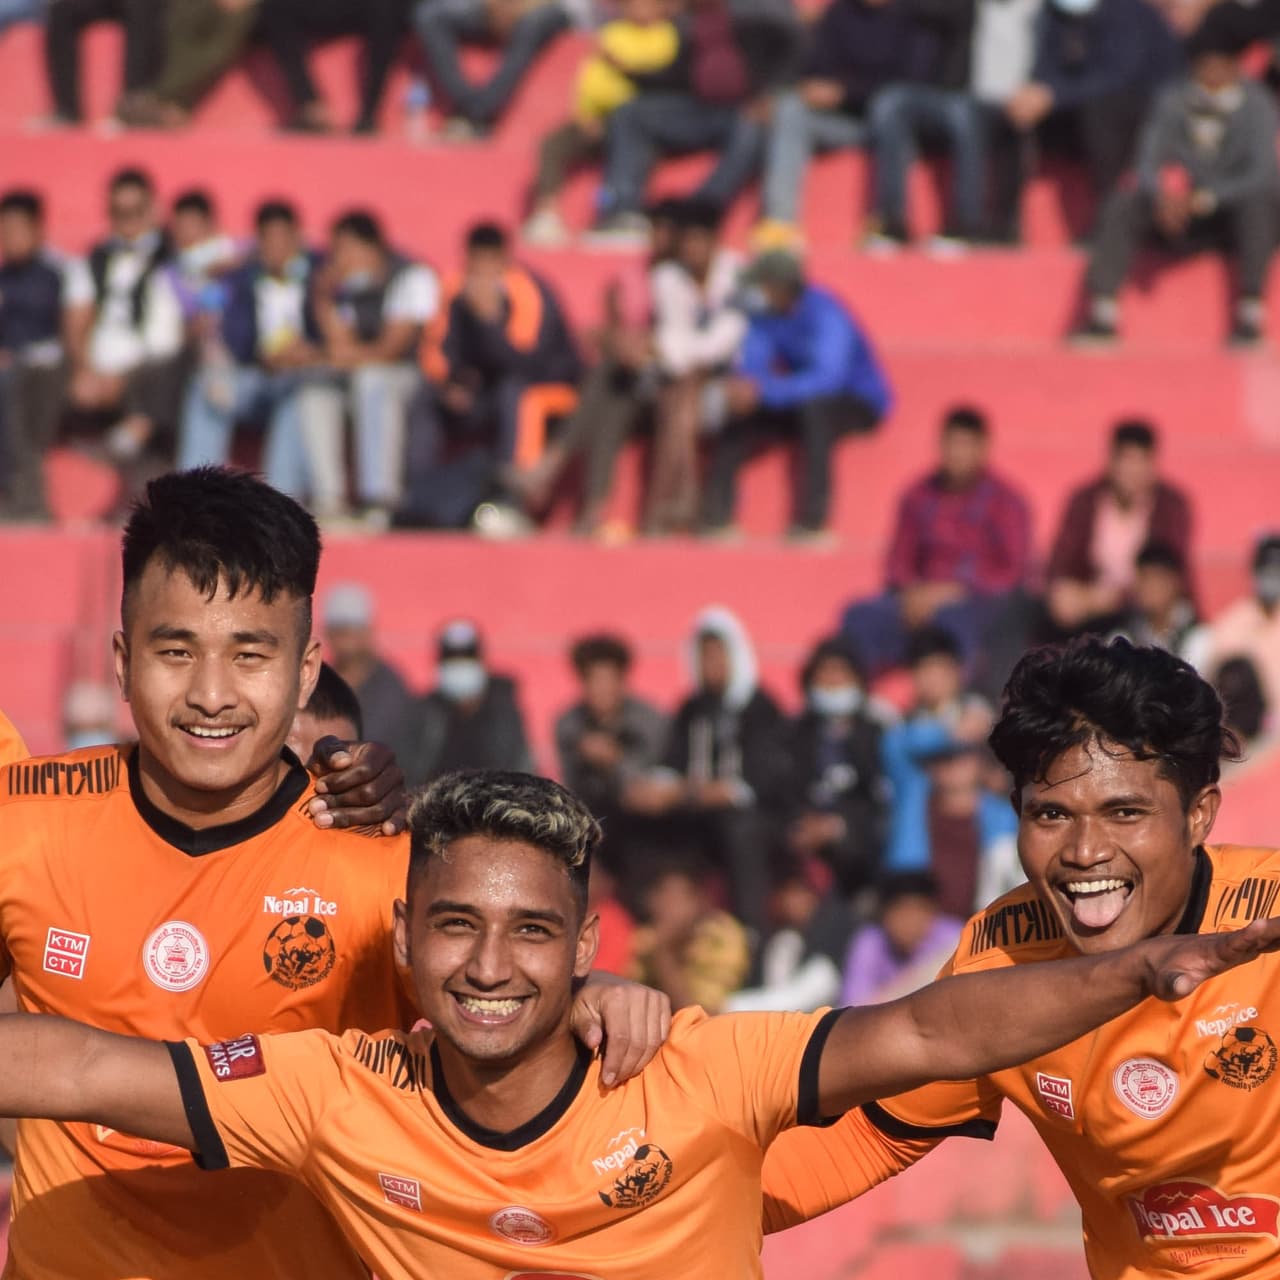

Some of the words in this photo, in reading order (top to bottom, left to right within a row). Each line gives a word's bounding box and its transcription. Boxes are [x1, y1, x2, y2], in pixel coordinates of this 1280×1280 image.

[263, 896, 309, 917] Nepal
[314, 897, 337, 915] Ice
[51, 934, 84, 952] KTM
[48, 956, 80, 973] CTY
[1041, 1078, 1067, 1095] KTM
[592, 1137, 639, 1177] Nepal
[384, 1178, 415, 1194] KTM
[1135, 1200, 1206, 1237] Nepal
[1208, 1205, 1256, 1227] Ice
